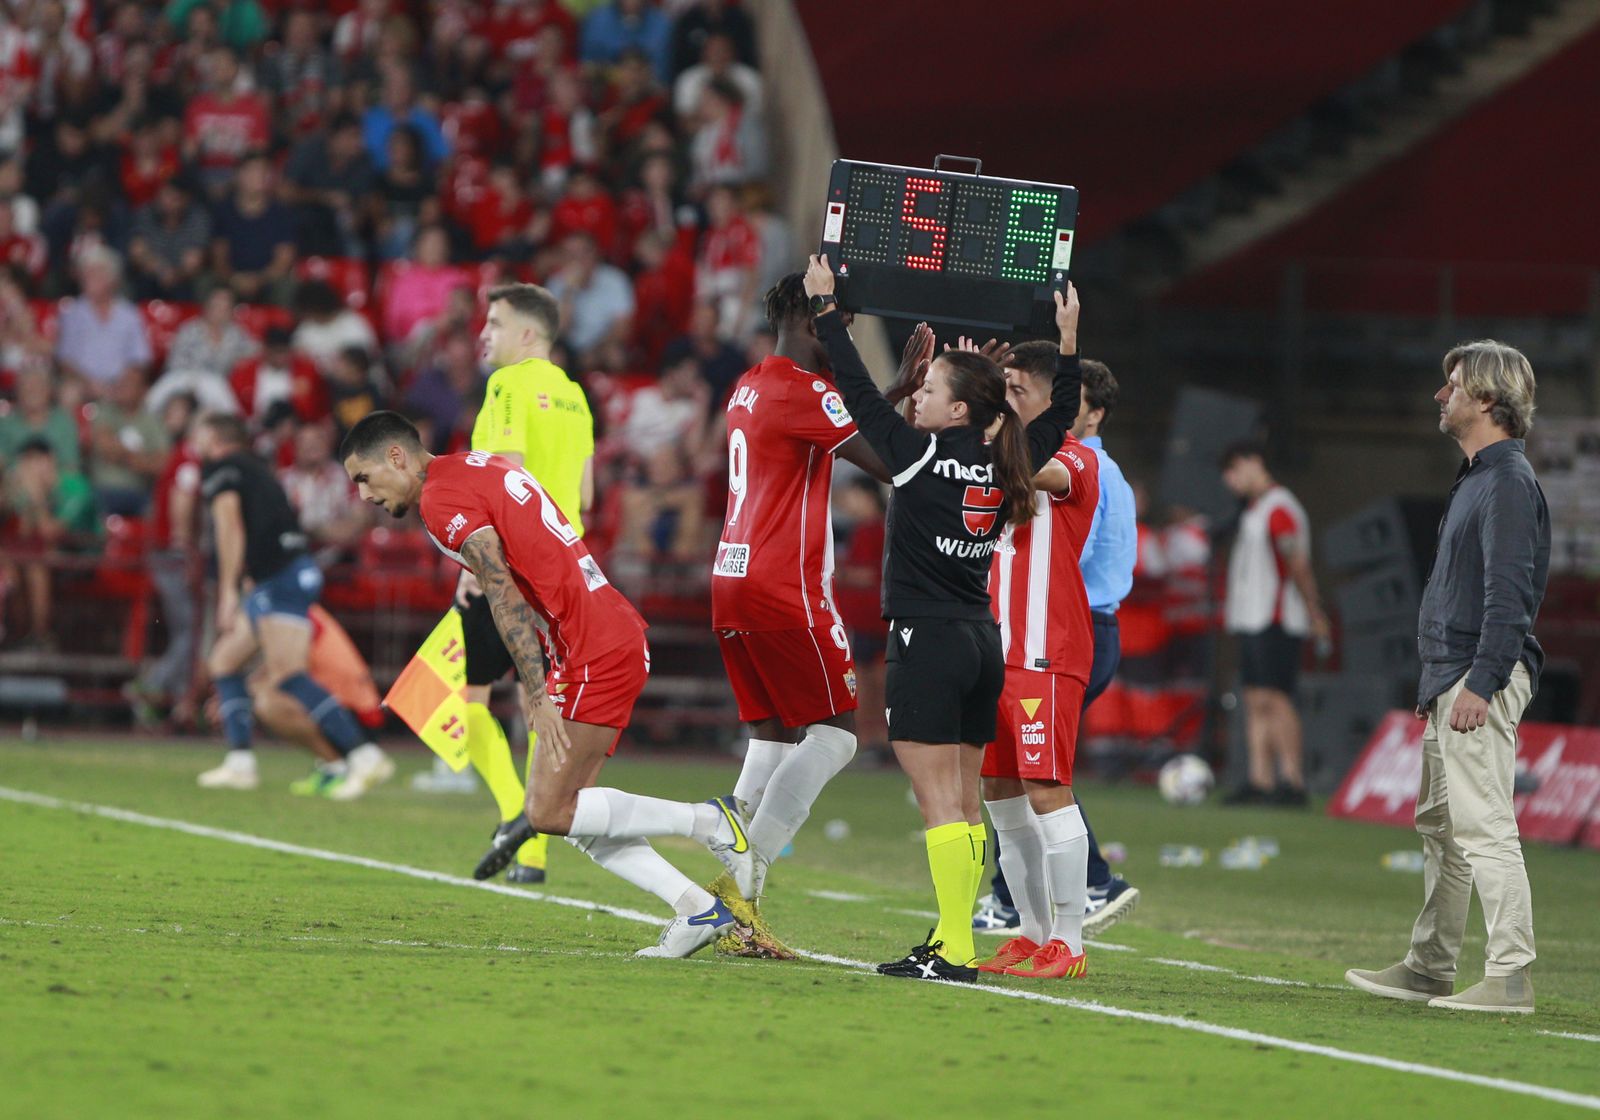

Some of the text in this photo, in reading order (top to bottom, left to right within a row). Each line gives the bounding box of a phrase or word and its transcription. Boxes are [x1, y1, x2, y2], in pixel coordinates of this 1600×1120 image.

[901, 177, 1058, 282] 5 8
[728, 428, 748, 526] 9
[932, 458, 994, 484] macr
[935, 535, 998, 559] WÜRTH
[830, 624, 851, 662] 9
[1021, 733, 1046, 745] KUDU
